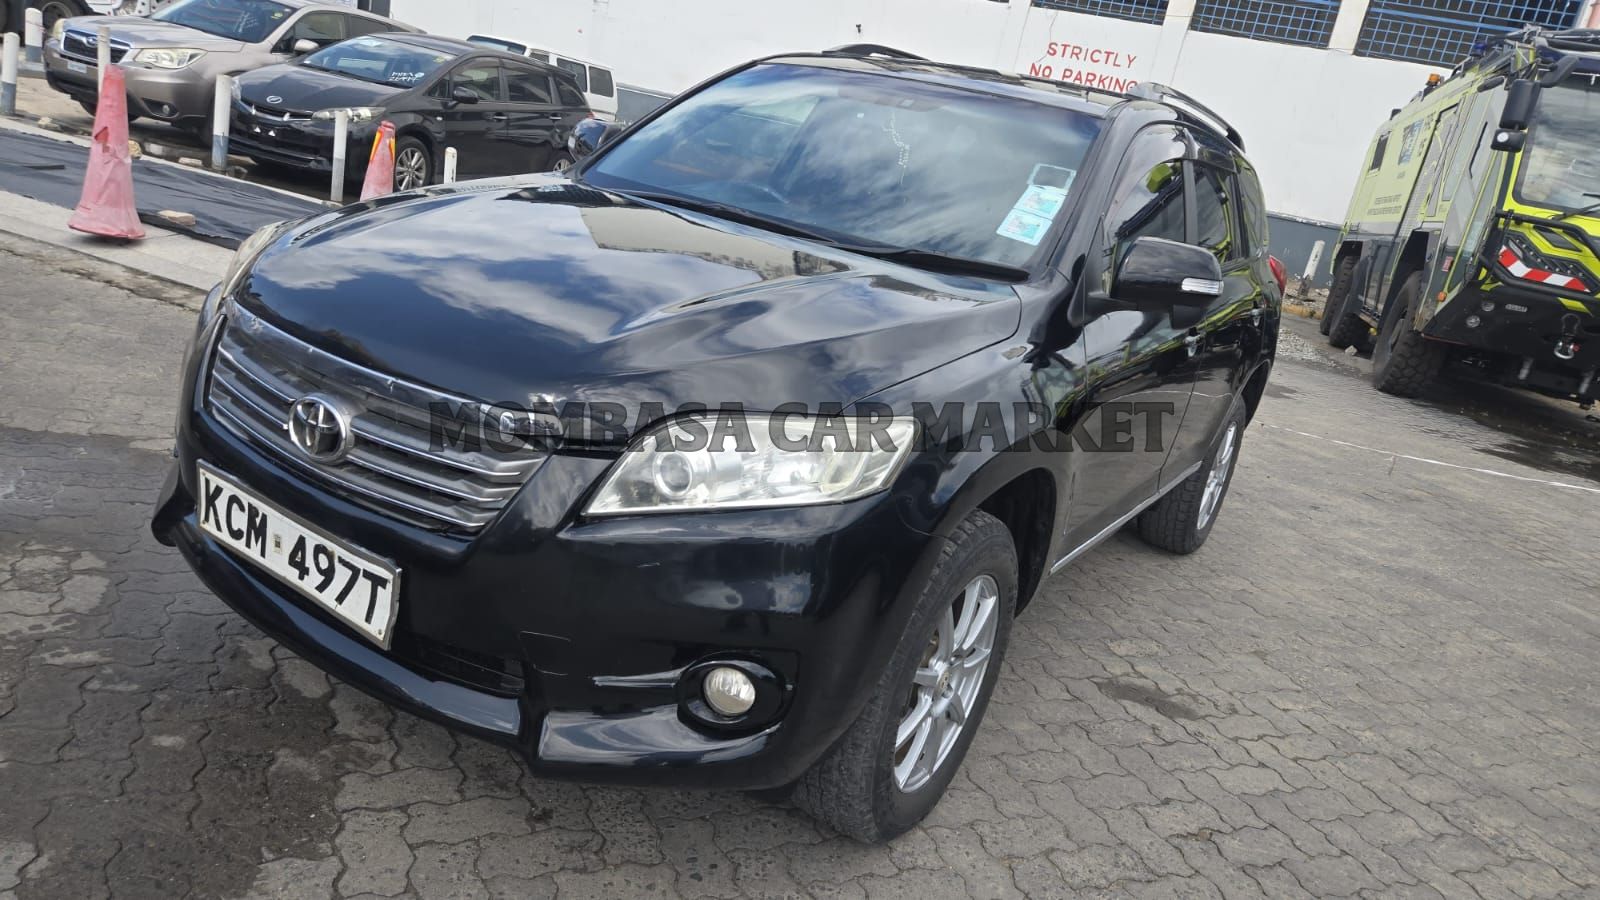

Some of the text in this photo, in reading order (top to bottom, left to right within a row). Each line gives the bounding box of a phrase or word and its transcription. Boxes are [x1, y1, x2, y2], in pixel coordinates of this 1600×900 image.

[1047, 42, 1136, 69] STRICTLY
[1029, 62, 1052, 79] NO
[203, 476, 389, 625] KCM 497T
